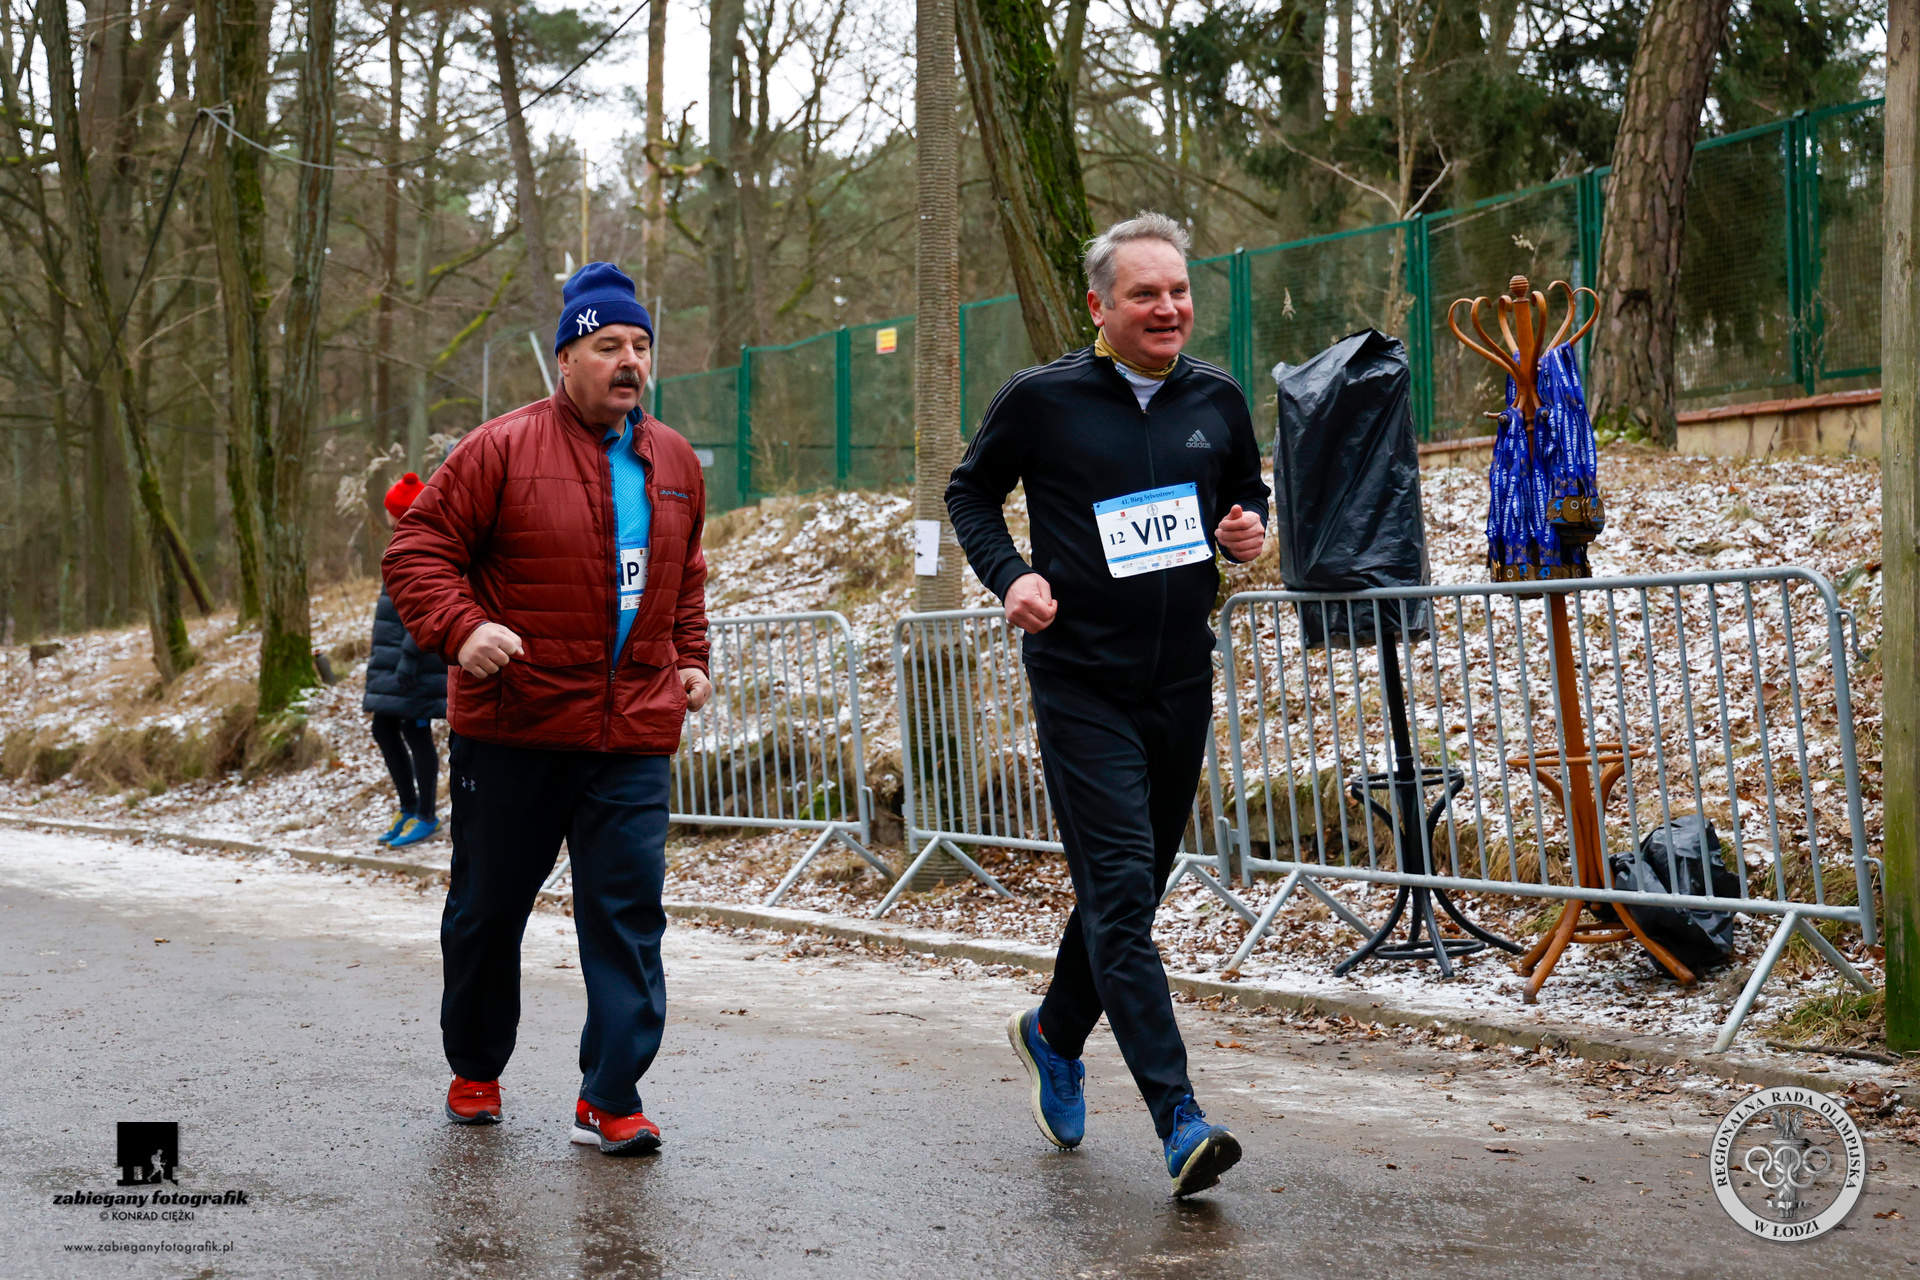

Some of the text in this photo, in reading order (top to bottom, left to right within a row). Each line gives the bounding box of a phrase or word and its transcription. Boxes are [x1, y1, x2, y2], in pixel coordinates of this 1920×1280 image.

[576, 308, 600, 336] NY
[1185, 441, 1211, 449] adidas
[1109, 514, 1197, 546] 12 VIP 12
[620, 561, 640, 586] IP
